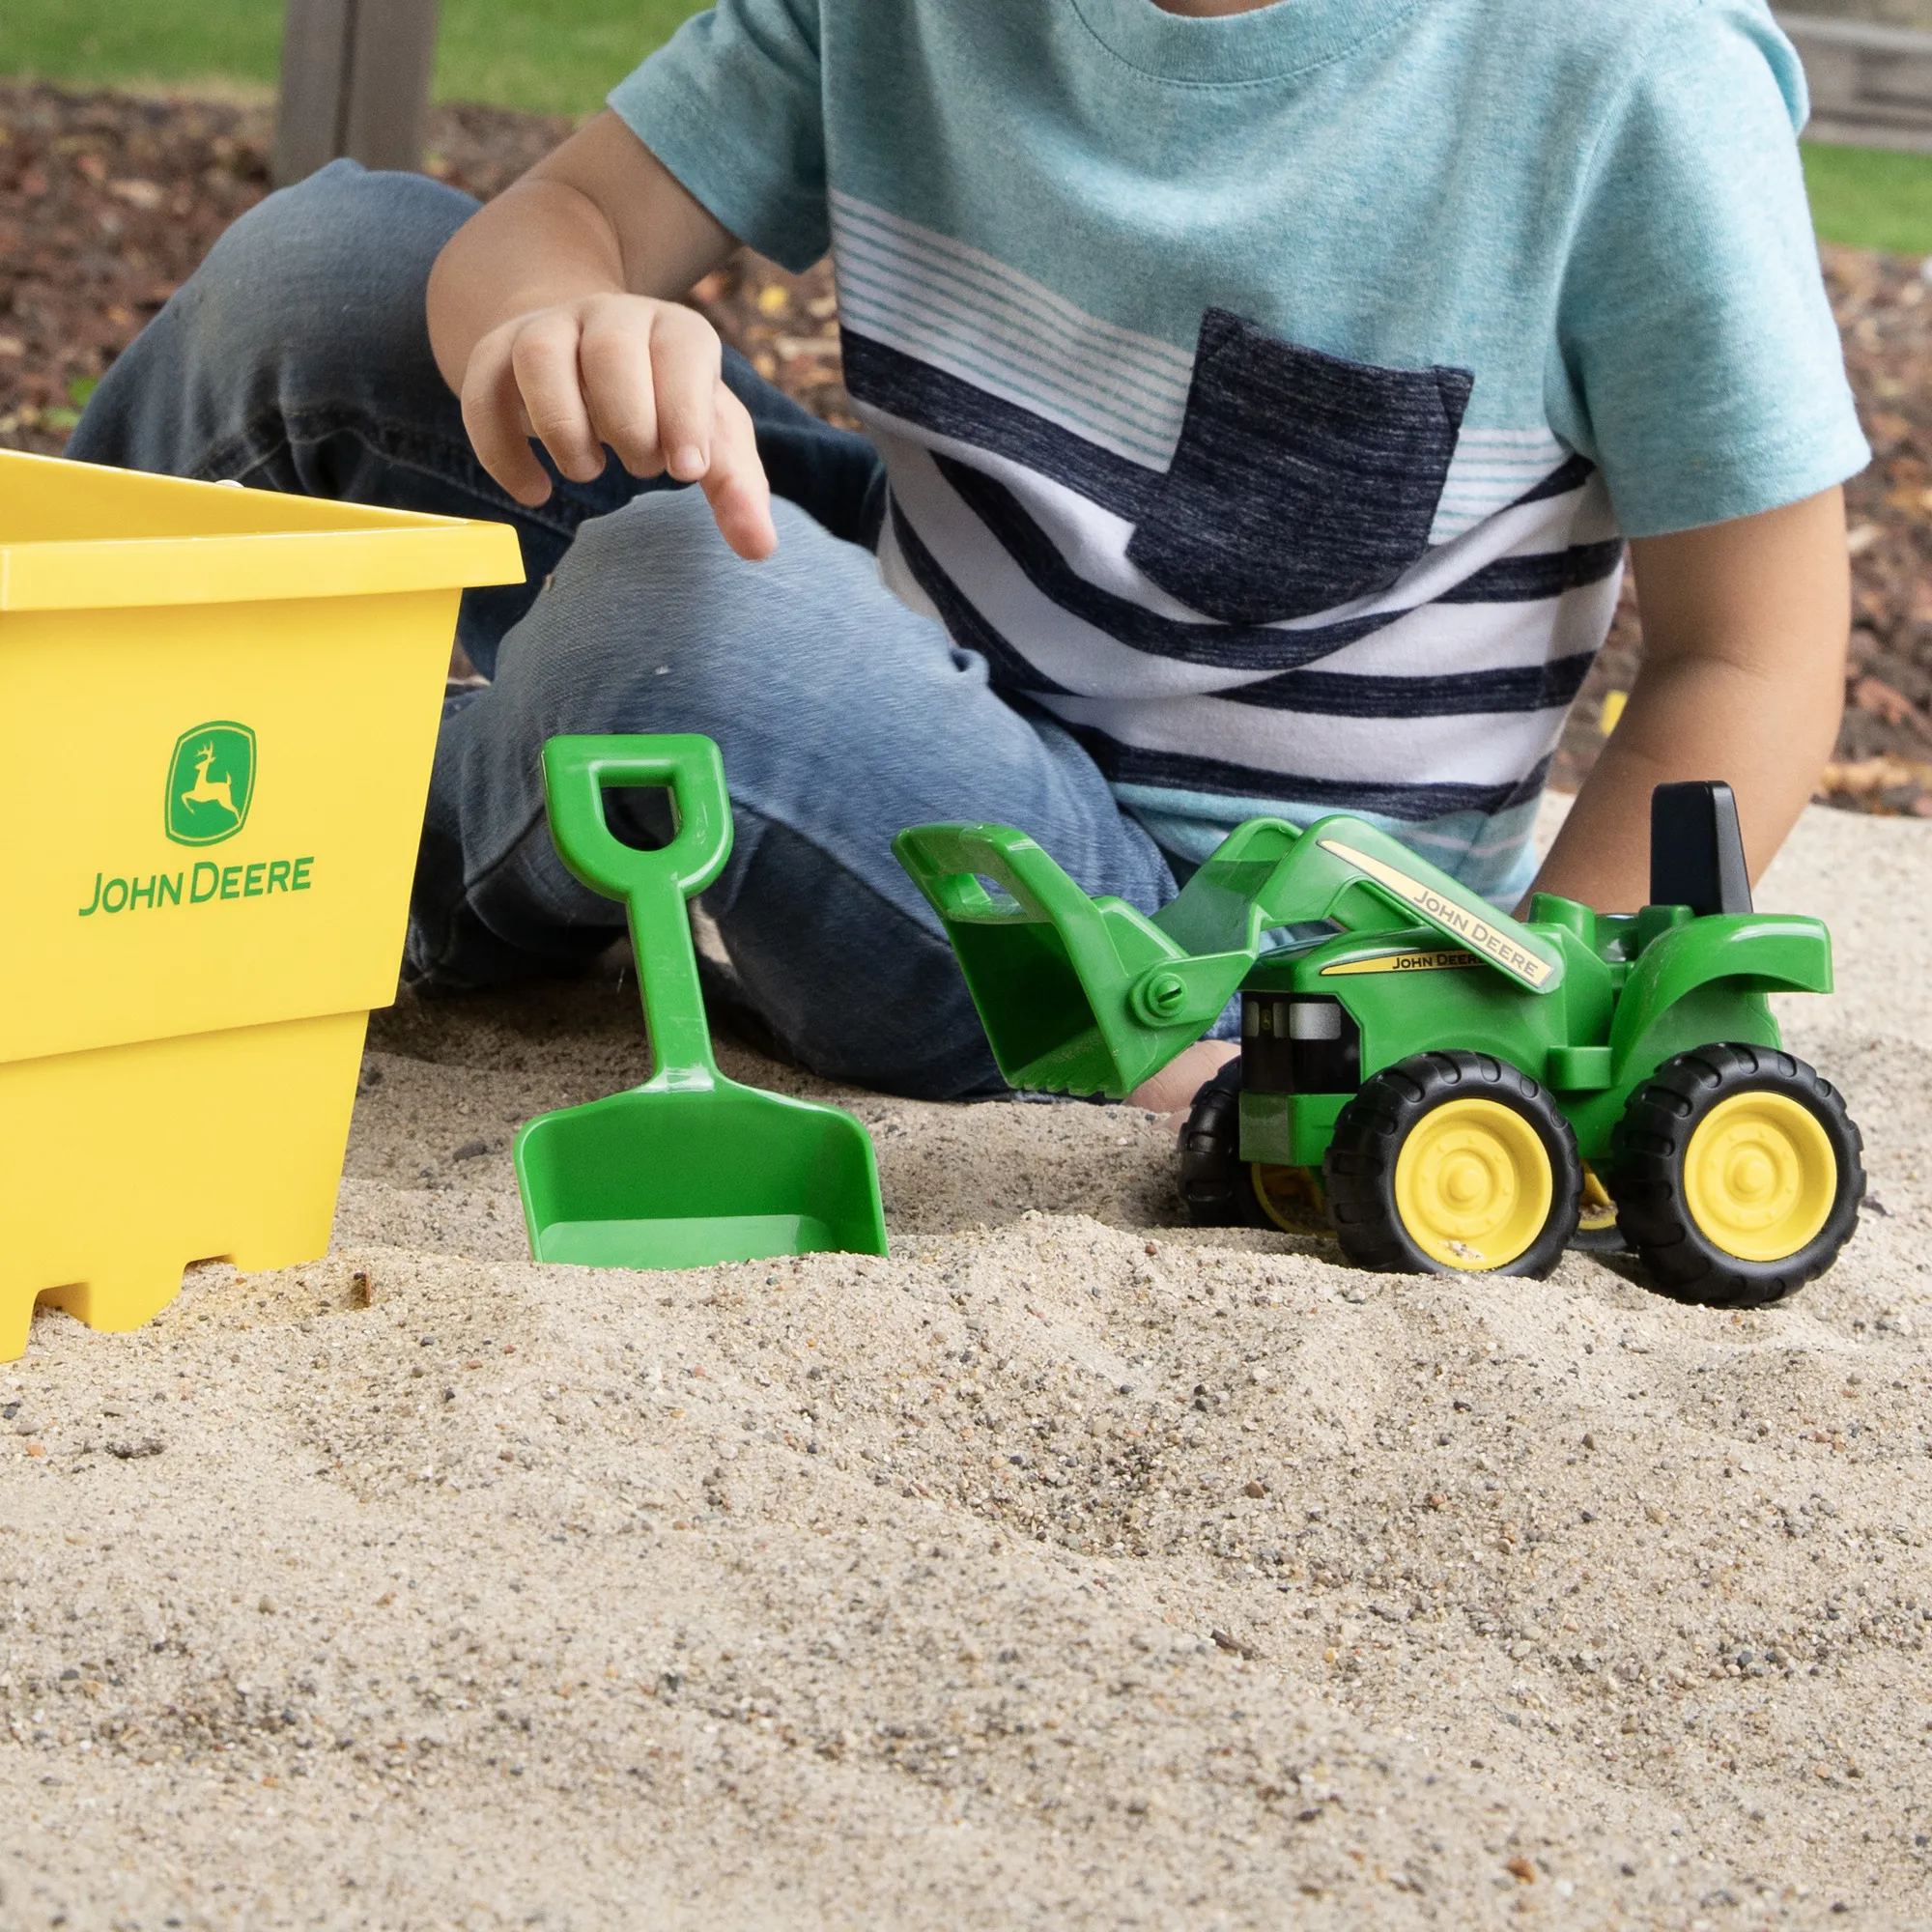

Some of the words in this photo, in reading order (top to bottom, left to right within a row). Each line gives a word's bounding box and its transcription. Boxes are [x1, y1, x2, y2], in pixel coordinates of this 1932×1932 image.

[78, 872, 184, 917] JOHN
[190, 857, 315, 903] DEERE
[1393, 956, 1433, 969] JOHN
[1413, 891, 1468, 932] JOHN
[1471, 923, 1539, 979] DEERE
